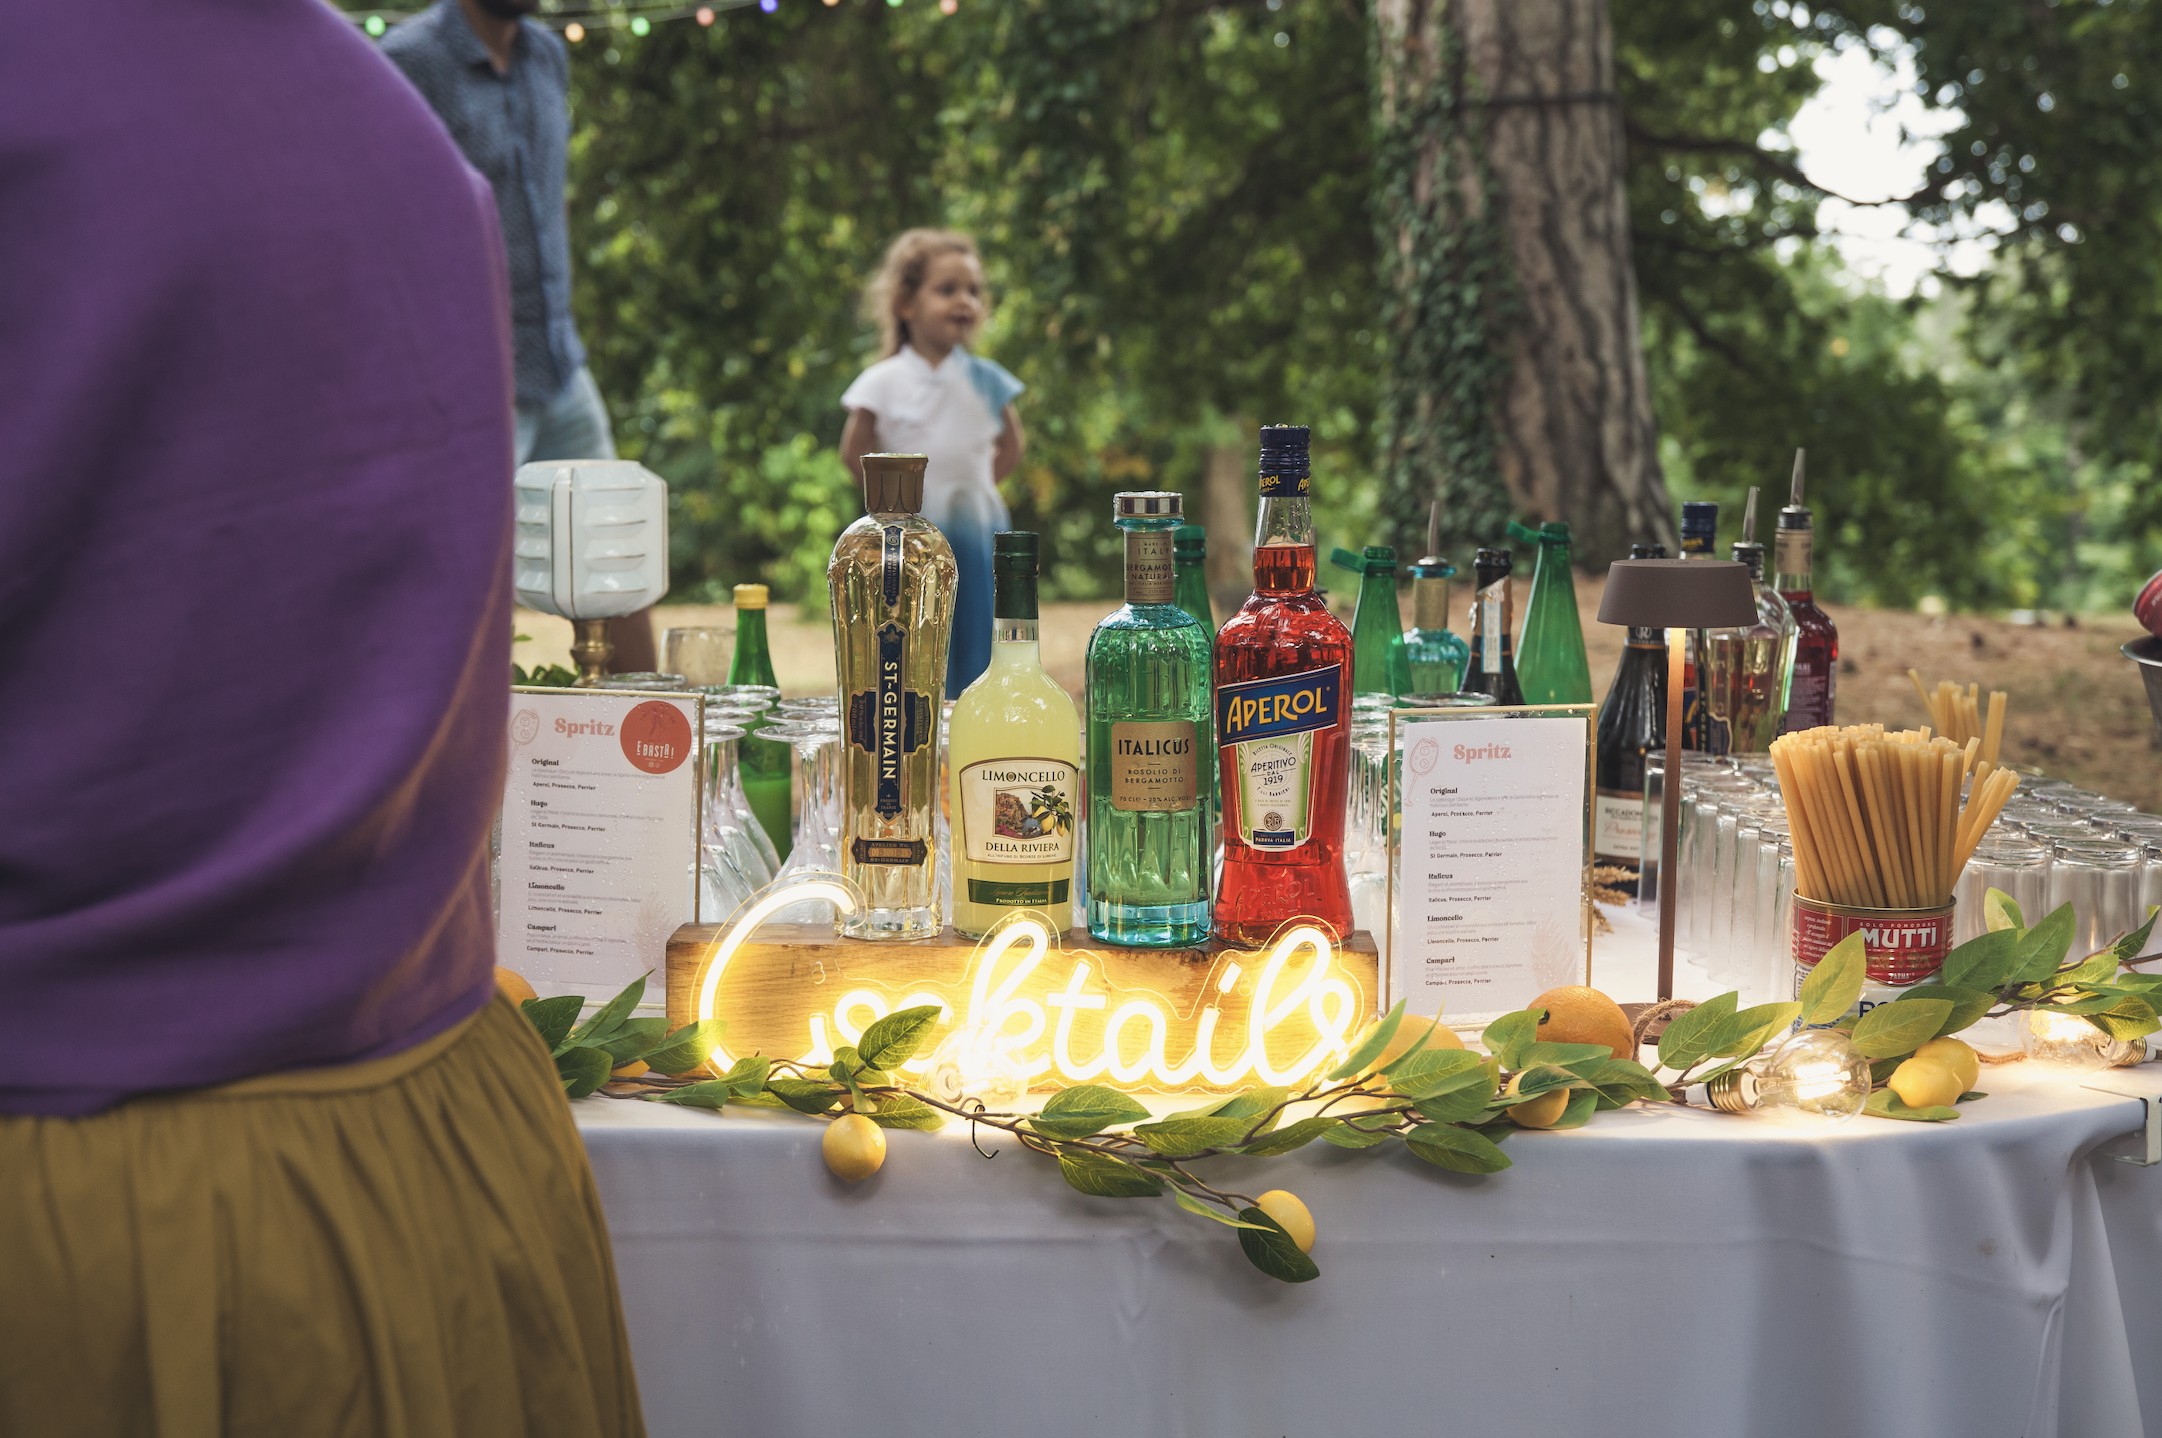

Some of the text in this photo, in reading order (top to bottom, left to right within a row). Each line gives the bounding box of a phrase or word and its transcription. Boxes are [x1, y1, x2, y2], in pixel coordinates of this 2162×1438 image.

[1227, 687, 1327, 734] APEROL
[554, 717, 614, 738] Spritz
[1119, 738, 1189, 755] ITALICUS
[1453, 742, 1512, 764] Spritz
[531, 758, 559, 767] Original
[1251, 757, 1296, 773] APERITIVO
[982, 770, 1065, 782] LIMONCELLO
[1264, 774, 1283, 785] 1919
[1430, 787, 1458, 796] Original
[530, 800, 548, 808] Hugo
[986, 842, 1060, 852] DELLA RIVIERA
[528, 882, 565, 890] Limoncello
[527, 924, 556, 932] Campari
[1860, 927, 1936, 948] MUTTI
[1426, 956, 1455, 965] Campari
